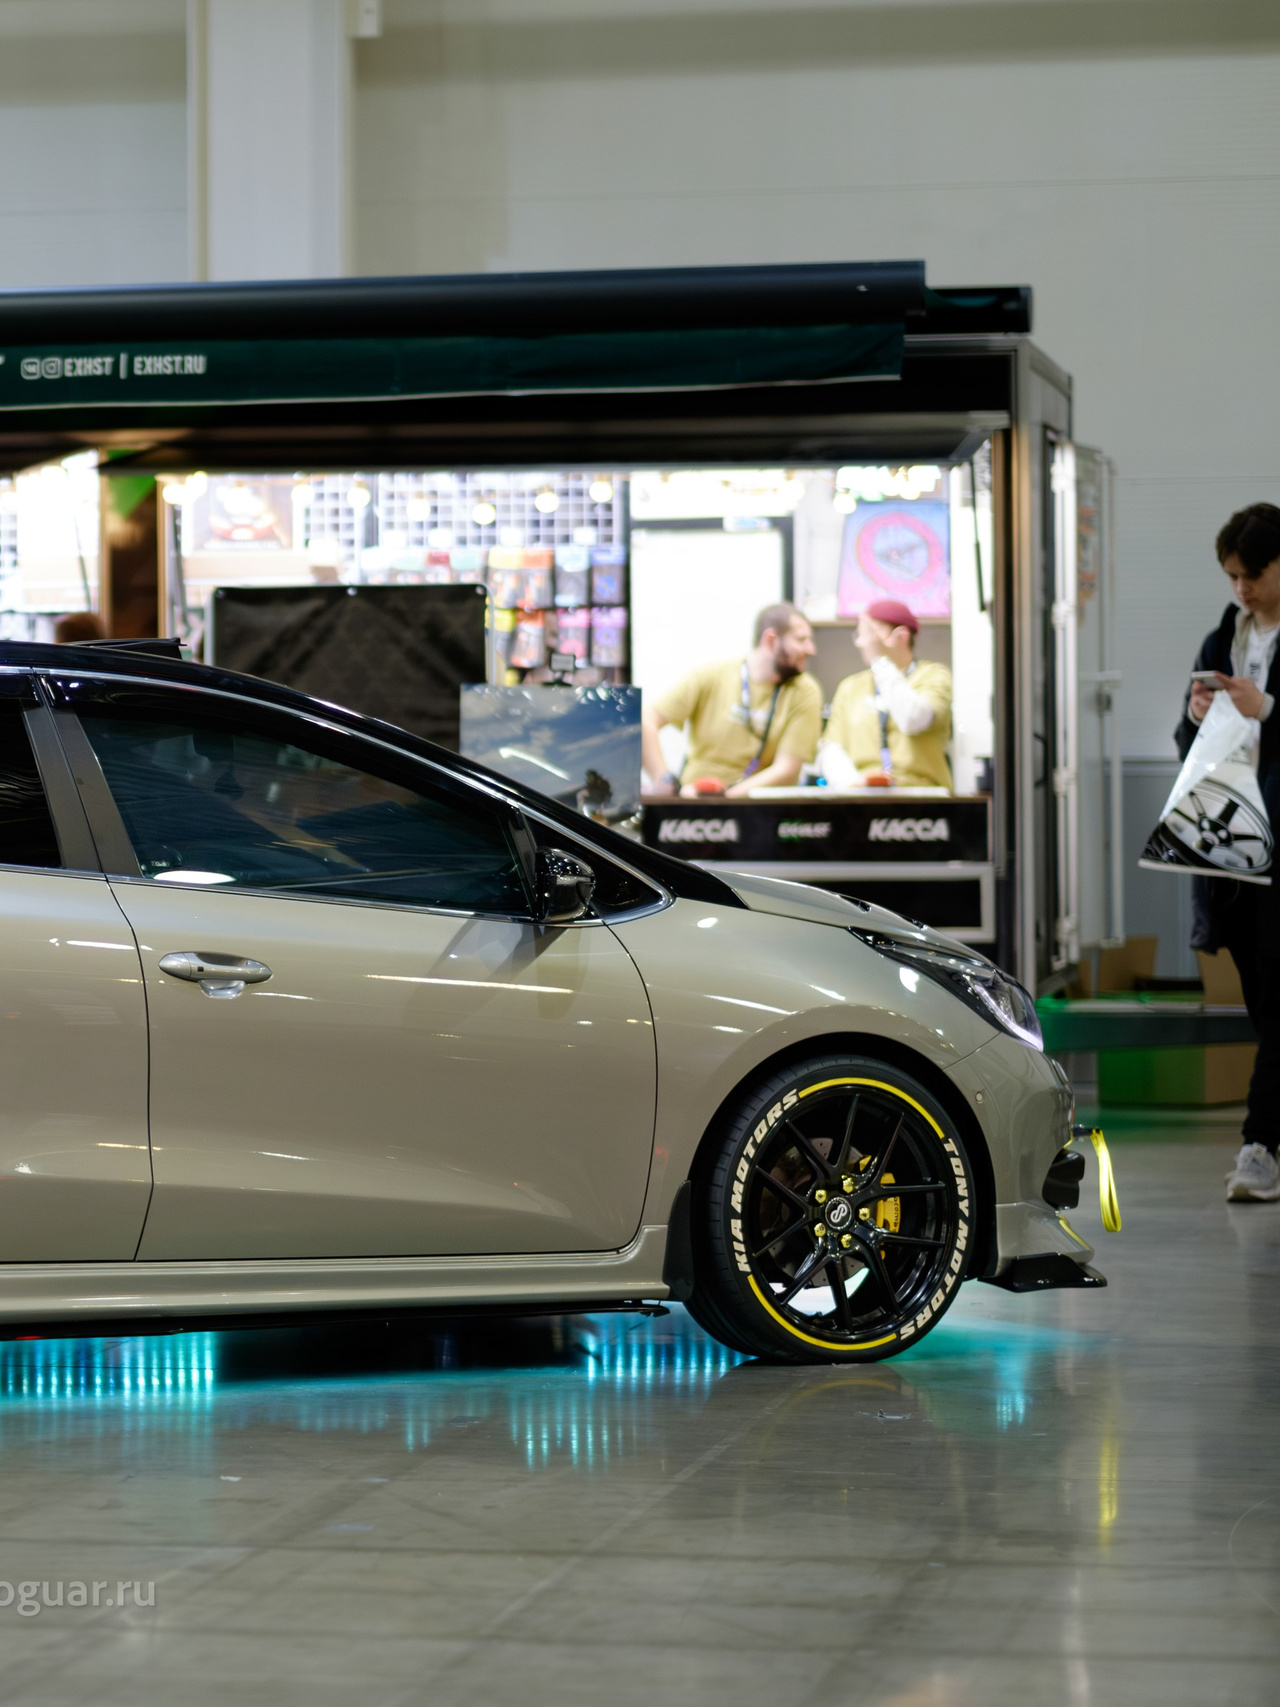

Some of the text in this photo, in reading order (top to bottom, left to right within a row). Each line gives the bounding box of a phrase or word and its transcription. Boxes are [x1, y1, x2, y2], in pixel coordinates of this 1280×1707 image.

[64, 357, 114, 377] EXHST
[133, 355, 207, 376] EXHST.RU
[658, 818, 739, 842] КАССА
[868, 818, 950, 841] КАССА
[730, 1088, 798, 1273] KIA MOTORS
[900, 1138, 969, 1340] TONY MOTORS
